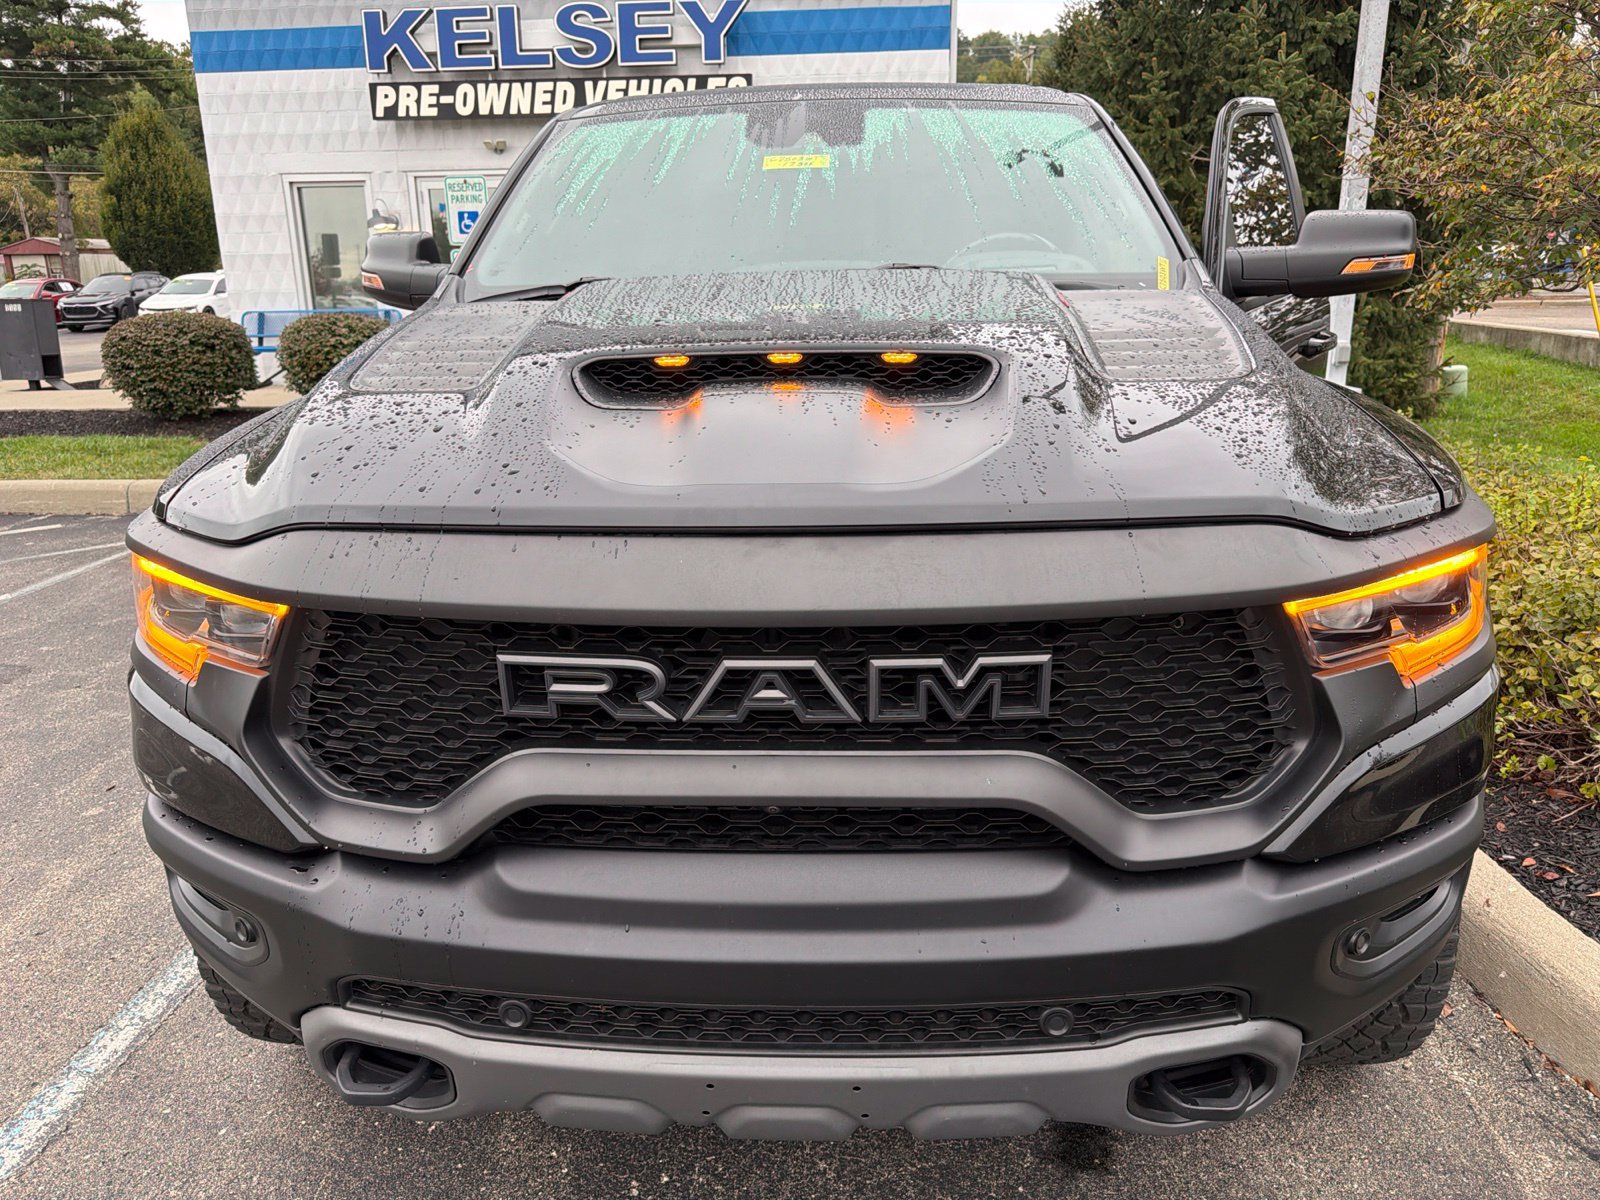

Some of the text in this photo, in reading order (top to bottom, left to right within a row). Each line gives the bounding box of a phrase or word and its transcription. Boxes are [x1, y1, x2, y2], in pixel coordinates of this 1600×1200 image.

[361, 0, 749, 73] KELSEY
[375, 81, 576, 118] PRE-OWNED
[448, 182, 483, 192] RESERVED
[451, 194, 482, 204] PARKING
[496, 652, 1052, 724] RAM
